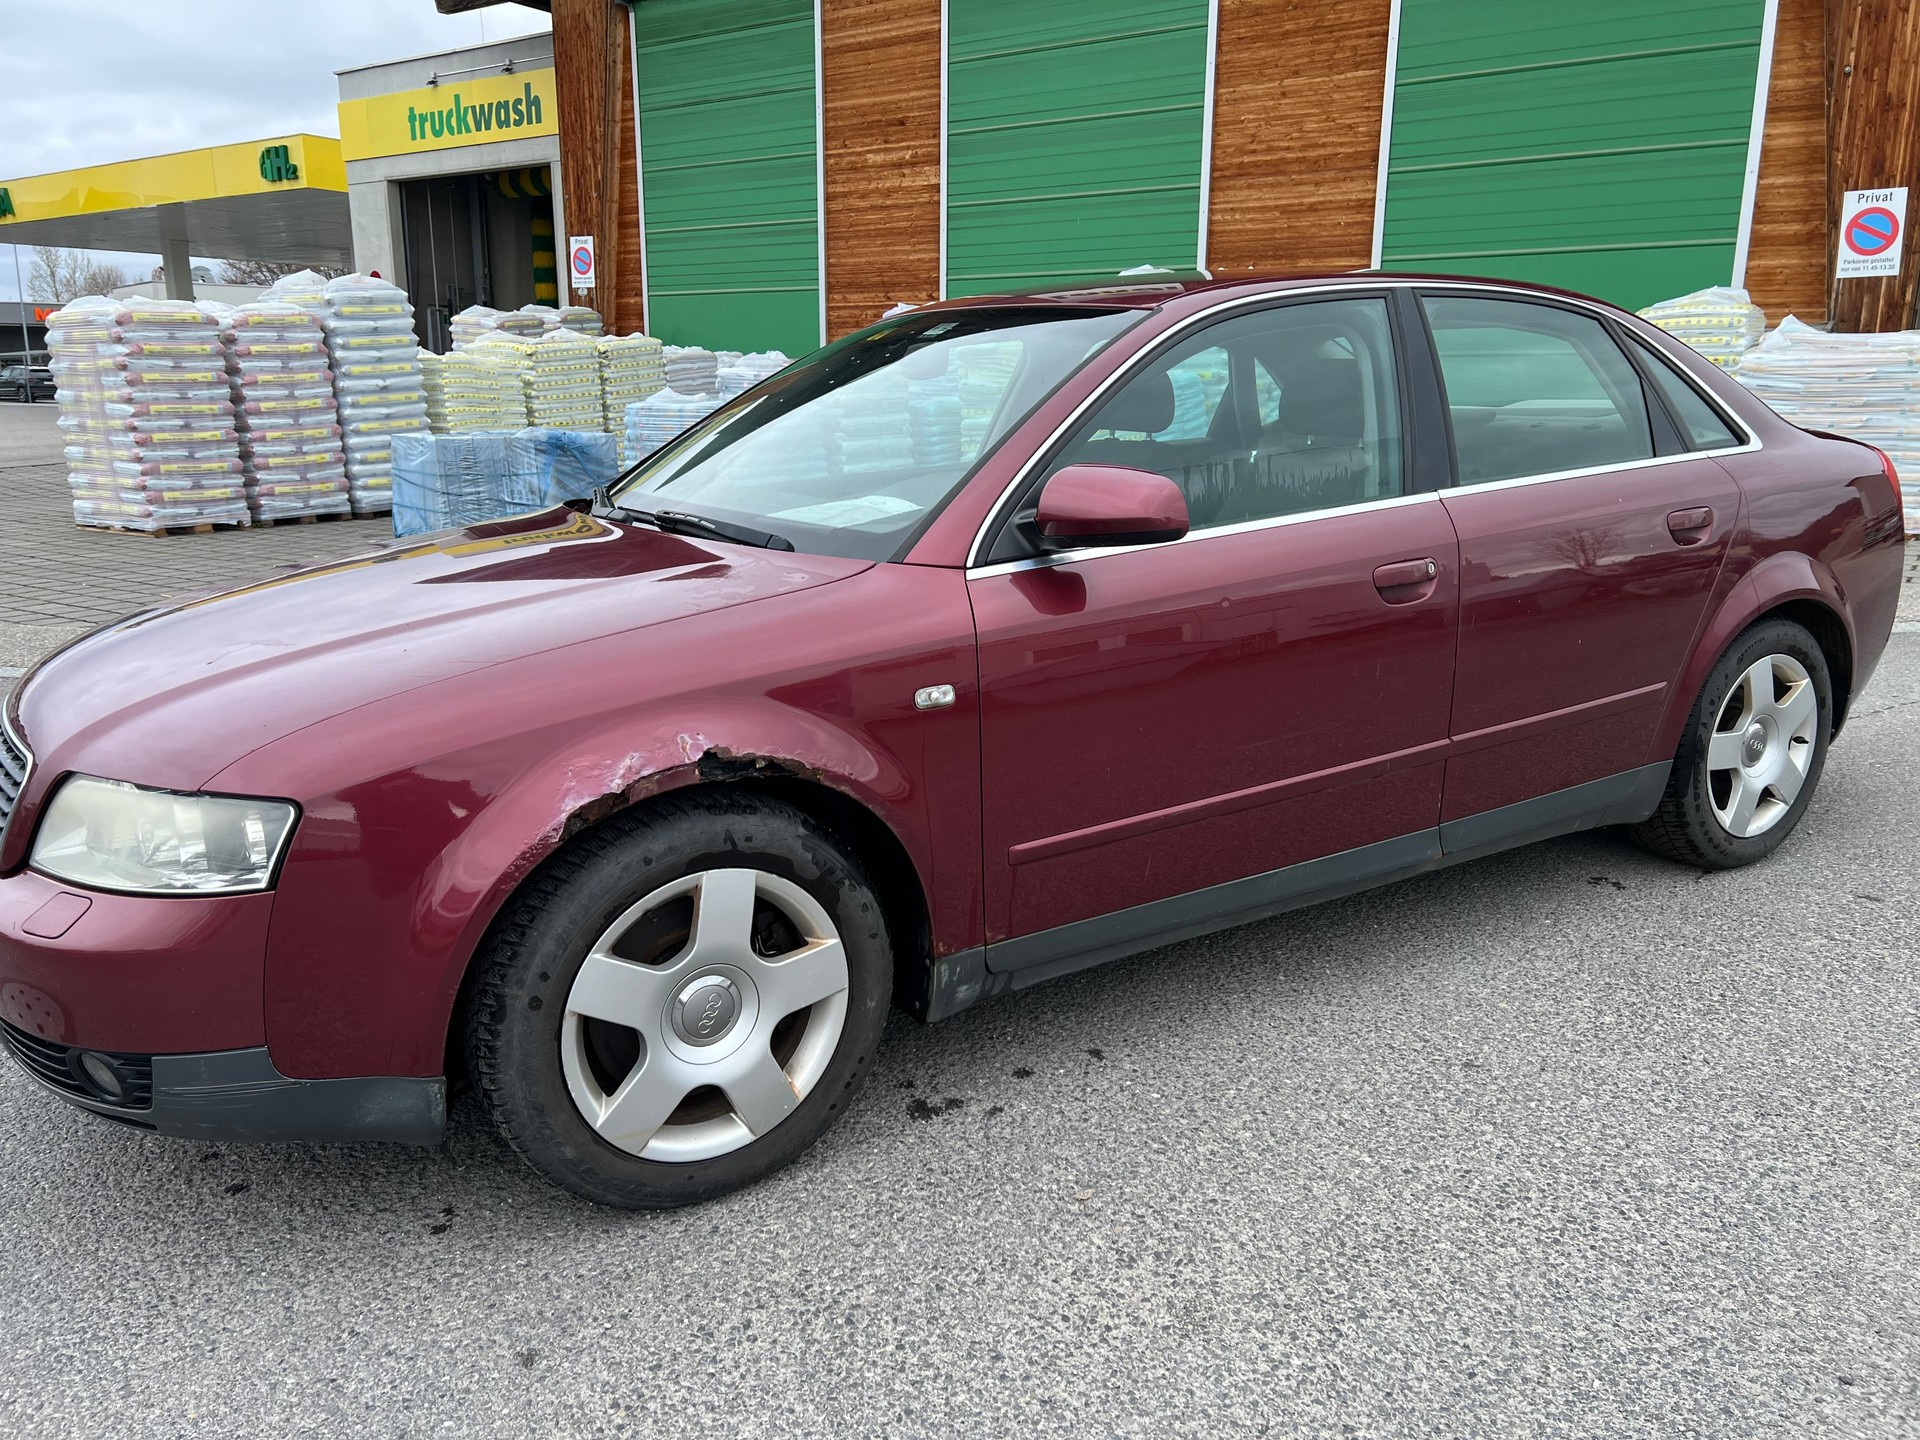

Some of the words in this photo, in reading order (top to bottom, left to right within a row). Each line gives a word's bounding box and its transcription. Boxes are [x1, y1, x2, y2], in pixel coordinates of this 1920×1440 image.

[407, 81, 543, 142] truckwash
[1858, 192, 1893, 203] Privat
[1870, 257, 1894, 265] gestattet
